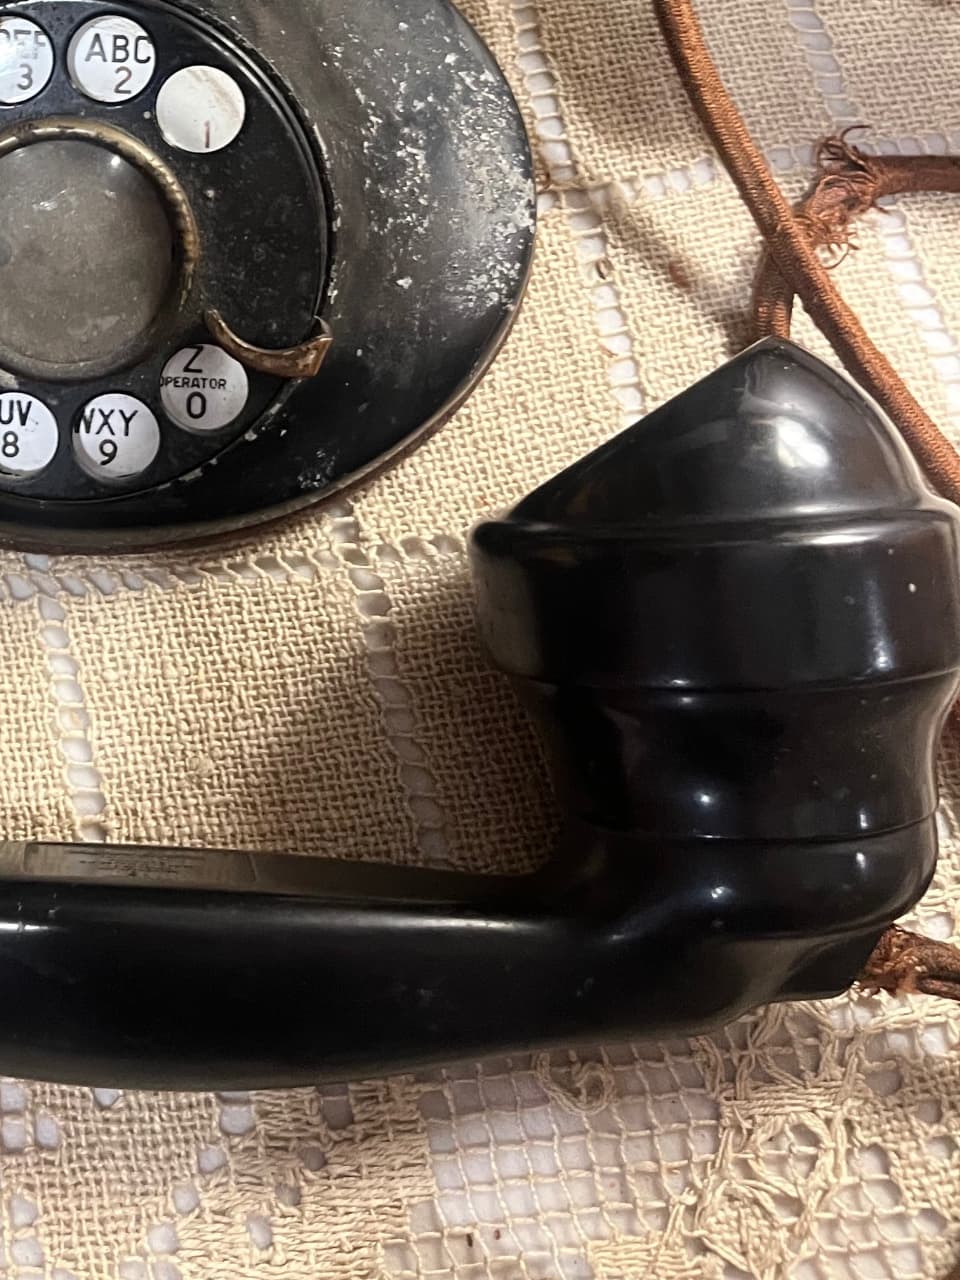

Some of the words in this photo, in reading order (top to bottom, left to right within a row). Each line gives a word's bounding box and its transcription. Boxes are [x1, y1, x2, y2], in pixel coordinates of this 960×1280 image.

[84, 32, 152, 64] ABC
[16, 63, 34, 91] 3
[113, 65, 132, 95] 2
[183, 345, 204, 374] Z
[186, 391, 207, 419] 0
[1, 430, 20, 458] 8
[99, 438, 119, 467] 9
